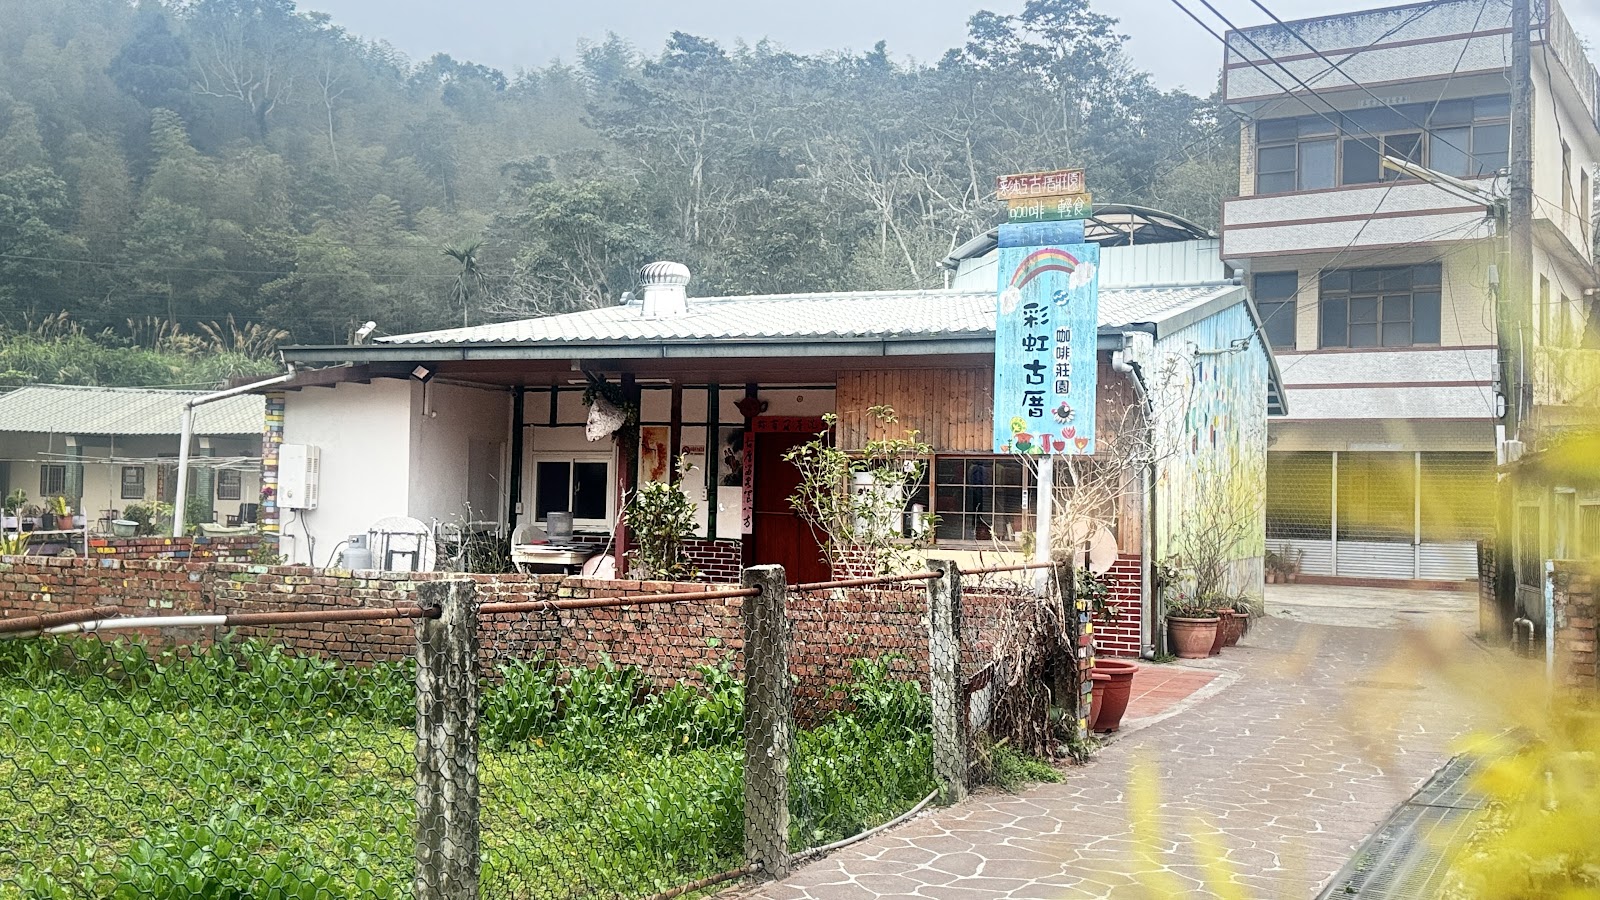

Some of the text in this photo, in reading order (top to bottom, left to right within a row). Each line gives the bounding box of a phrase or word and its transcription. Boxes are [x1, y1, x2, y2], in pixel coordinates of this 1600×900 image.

[999, 171, 1081, 196] 彩虹古厝莊園
[1009, 196, 1085, 220] 咖啡 輕食
[1022, 302, 1050, 418] 彩虹古厝
[1055, 328, 1071, 395] 咖啡莊園
